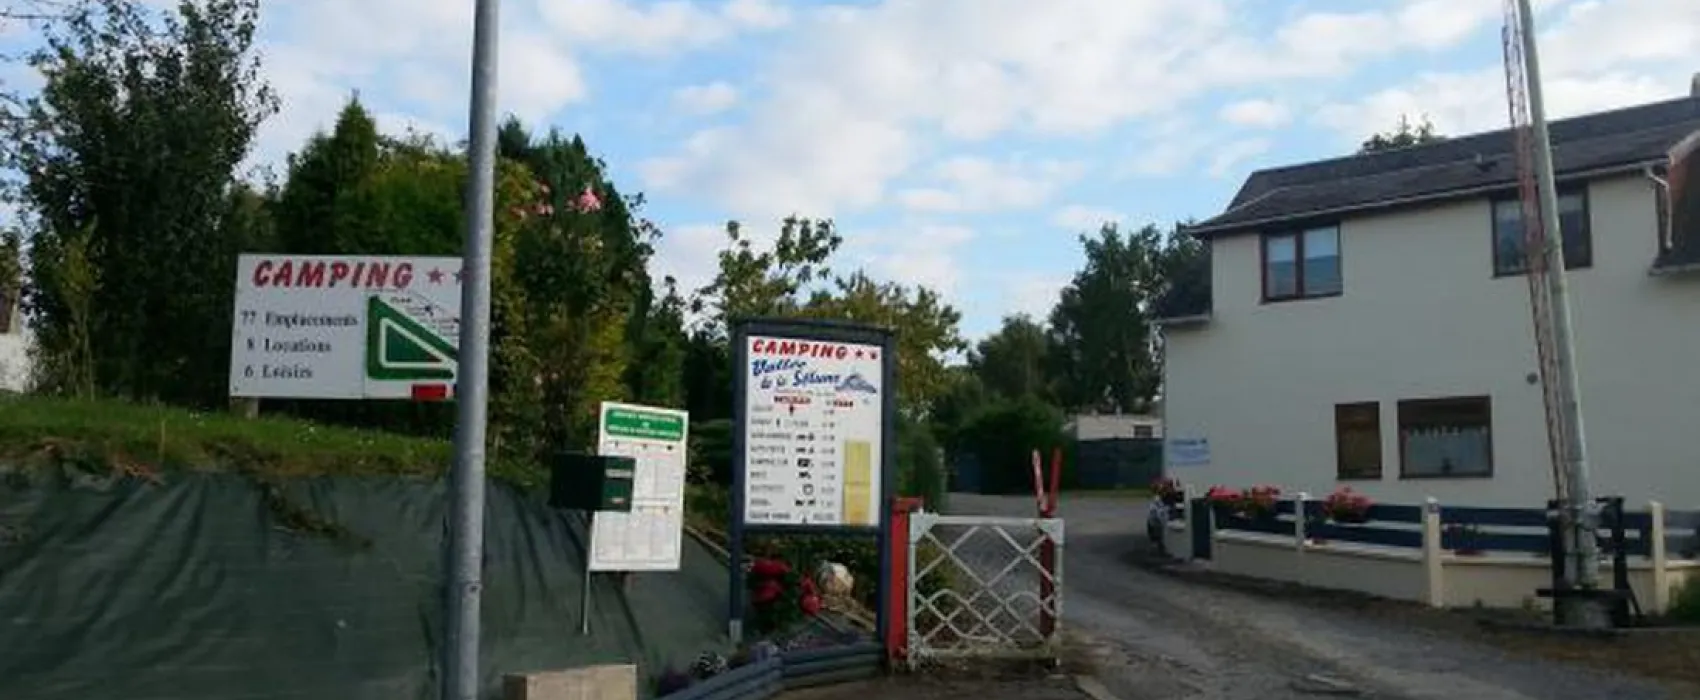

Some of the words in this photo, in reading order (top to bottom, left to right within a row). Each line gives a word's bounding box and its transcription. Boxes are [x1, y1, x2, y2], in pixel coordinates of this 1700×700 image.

[253, 260, 413, 288] CAMPING
[265, 312, 358, 330] Emplacements
[265, 338, 332, 352] Locations
[752, 339, 848, 360] CAMPING
